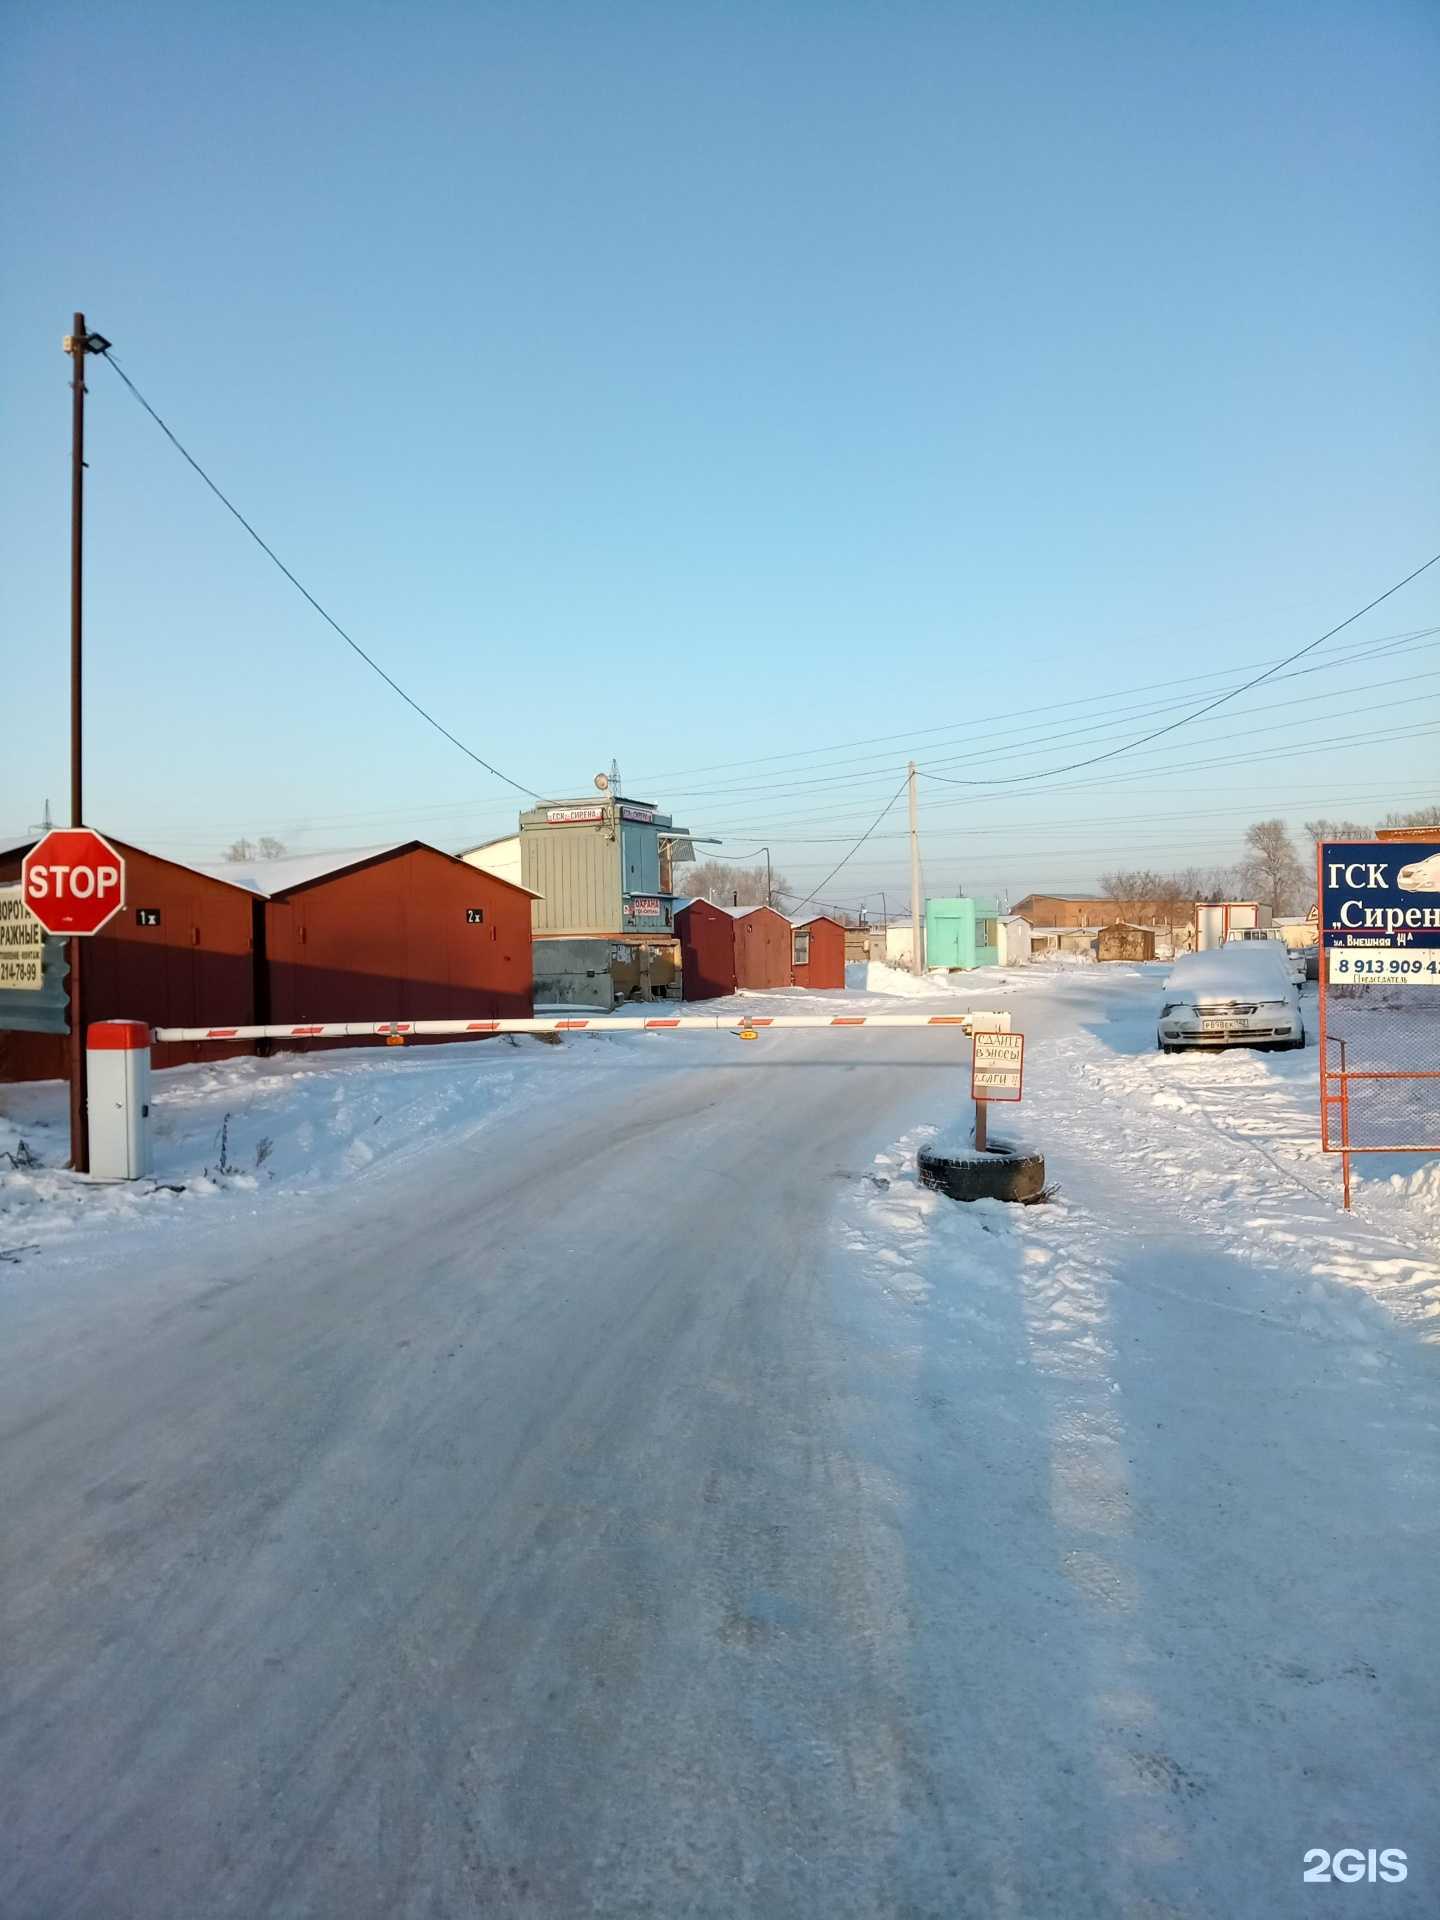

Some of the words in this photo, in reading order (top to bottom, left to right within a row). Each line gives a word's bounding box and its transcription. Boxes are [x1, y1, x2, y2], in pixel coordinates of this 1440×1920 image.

[28, 865, 118, 899] STOP
[1328, 863, 1389, 889] ГСК
[1338, 960, 1349, 973] 8
[1354, 960, 1384, 973] 913
[1389, 960, 1422, 973] 909
[1426, 960, 1440, 974] 4
